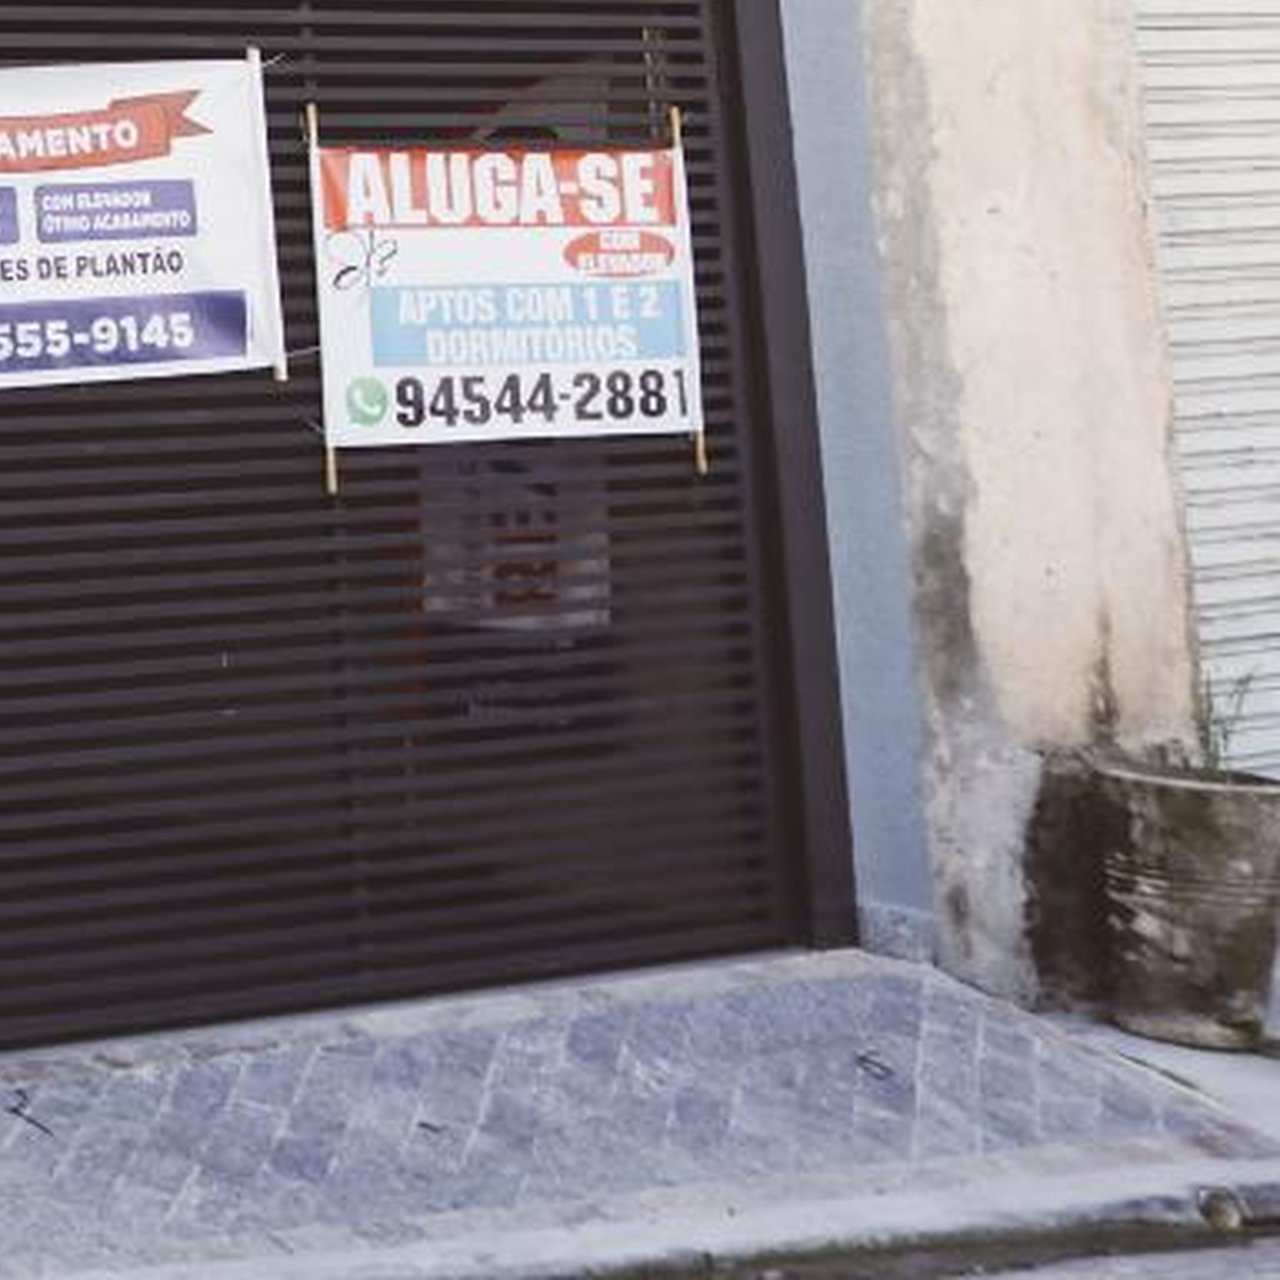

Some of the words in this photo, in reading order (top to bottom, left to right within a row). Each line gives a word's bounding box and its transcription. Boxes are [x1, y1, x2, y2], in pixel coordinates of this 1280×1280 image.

[346, 152, 656, 226] ALUGA-SE
[39, 257, 70, 280] DE
[76, 245, 183, 278] PLANTÃO
[399, 289, 496, 324] APTOS
[505, 287, 573, 322] COM
[612, 285, 630, 318] E
[641, 284, 662, 318] 2
[395, 369, 689, 427] 94544-2881
